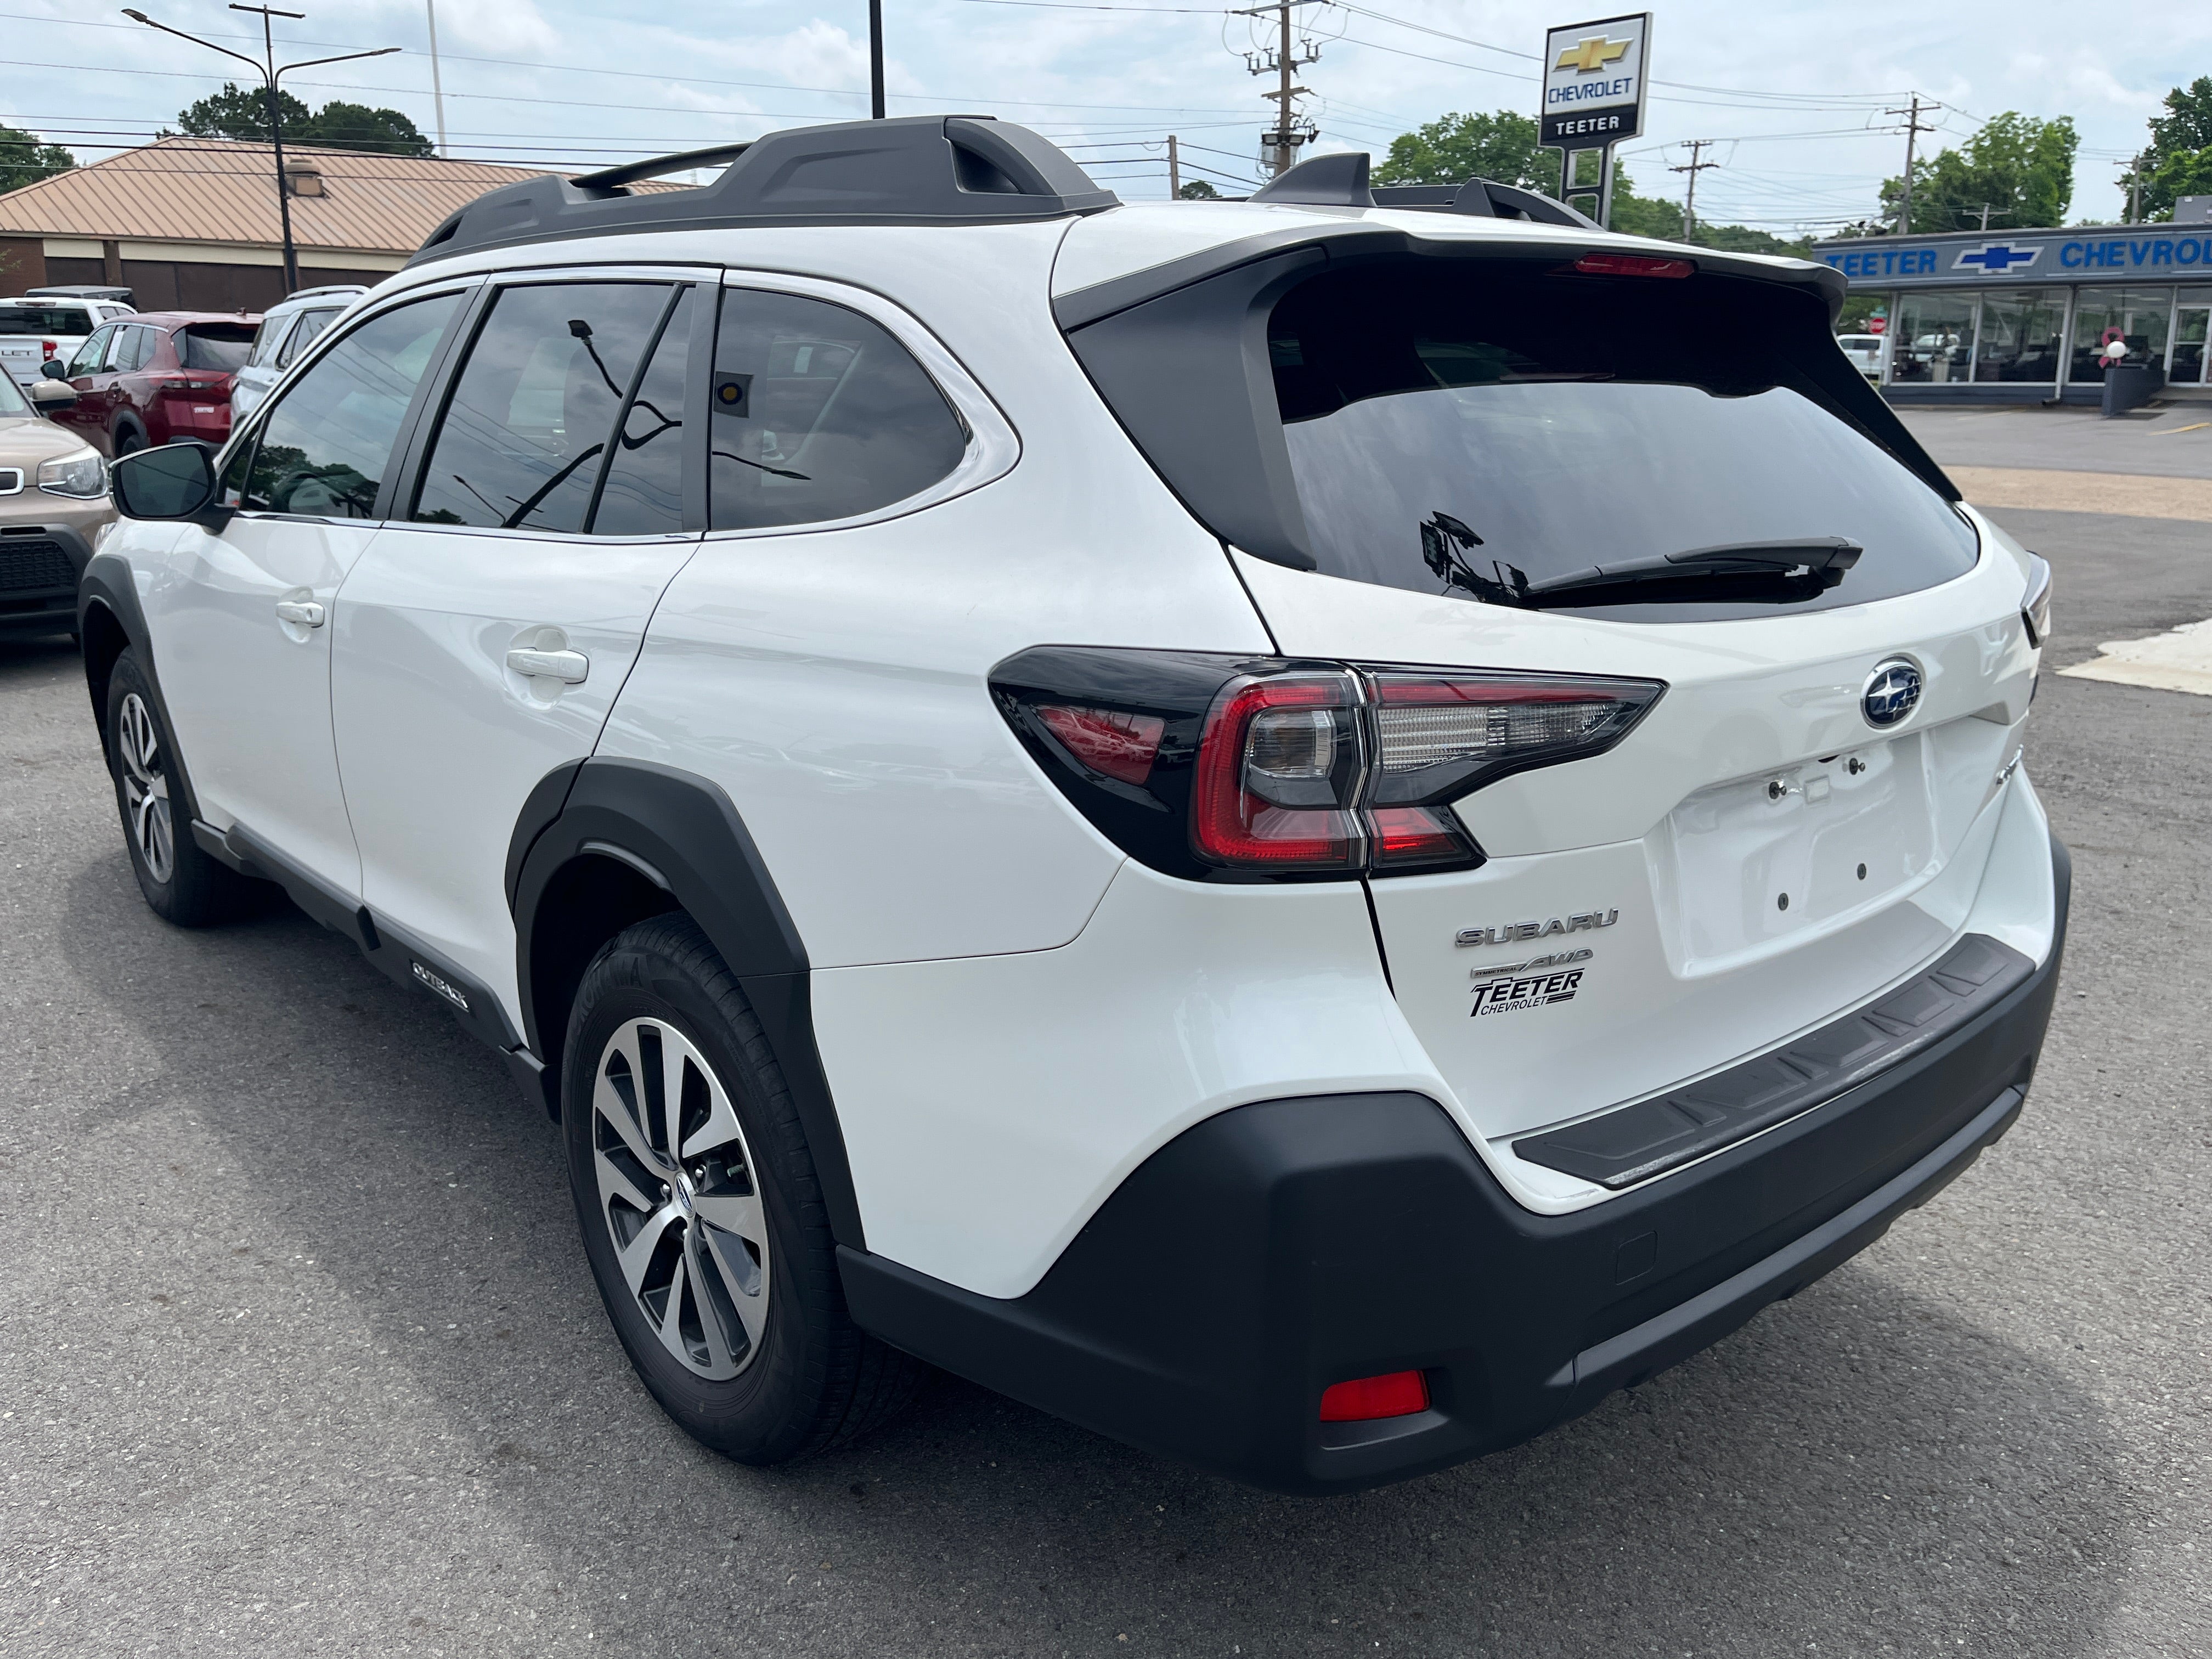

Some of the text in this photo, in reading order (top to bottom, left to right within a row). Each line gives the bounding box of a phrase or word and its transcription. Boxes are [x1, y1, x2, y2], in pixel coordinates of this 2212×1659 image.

[1549, 77, 1633, 103] CHEVROLET
[1556, 116, 1620, 135] TEETER
[1825, 250, 1937, 276] TEETER
[1455, 908, 1618, 947] SUBARU
[1475, 947, 1593, 976] SYMMETRICAL AWD
[1470, 970, 1584, 1017] TEETER
[1481, 996, 1546, 1015] CHEVROLET
